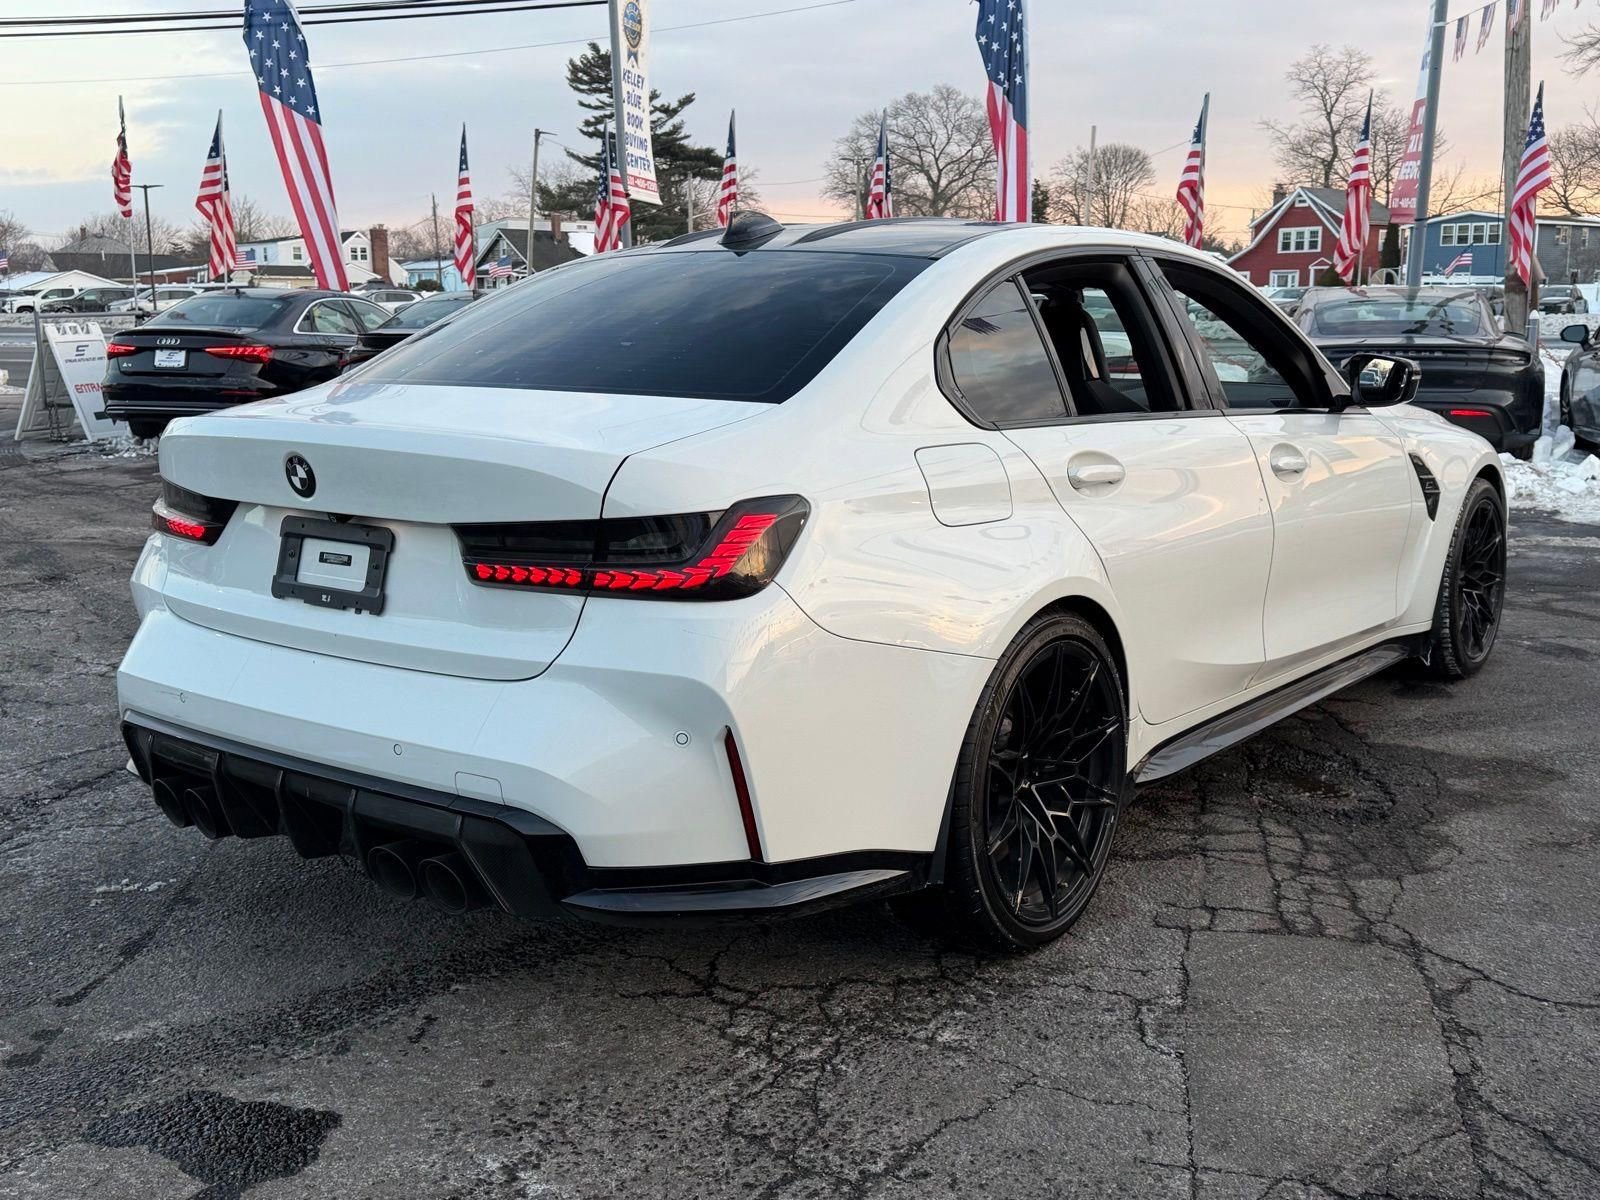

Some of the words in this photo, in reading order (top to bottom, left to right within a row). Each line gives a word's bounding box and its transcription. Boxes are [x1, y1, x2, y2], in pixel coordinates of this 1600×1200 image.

[623, 68, 644, 89] KELLEY
[627, 91, 641, 109] BLUE
[627, 112, 643, 129] BOOK
[625, 132, 647, 151] BUYING
[626, 152, 651, 173] CENTER
[286, 456, 309, 471] BMW
